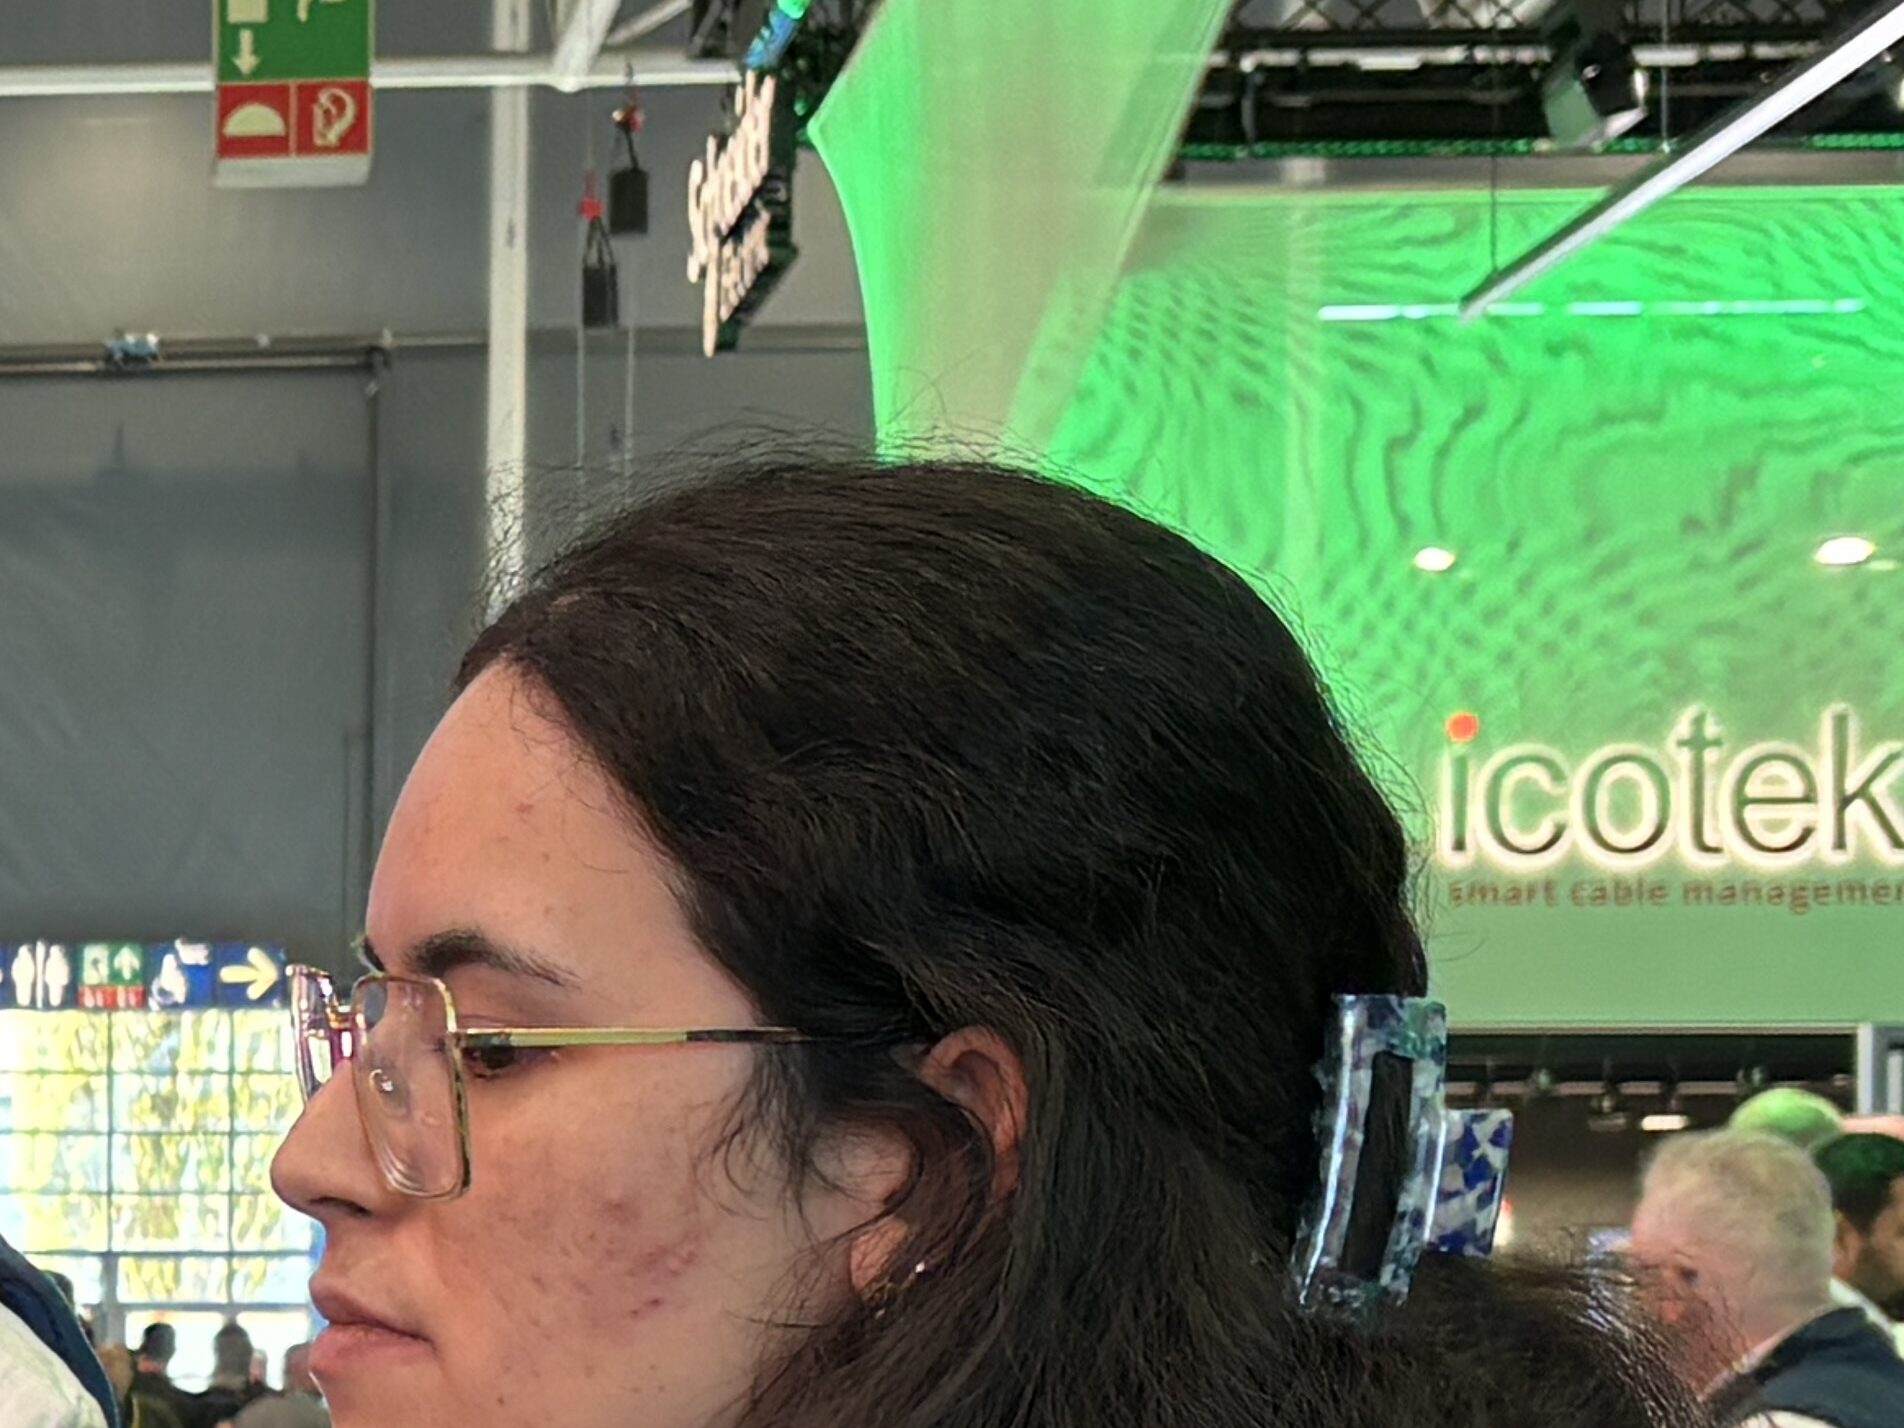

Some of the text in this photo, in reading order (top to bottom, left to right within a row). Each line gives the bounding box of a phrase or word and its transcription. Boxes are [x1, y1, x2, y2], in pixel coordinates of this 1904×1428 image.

[1445, 708, 1904, 862] icotek
[1449, 876, 1904, 915] smart cable manageme
